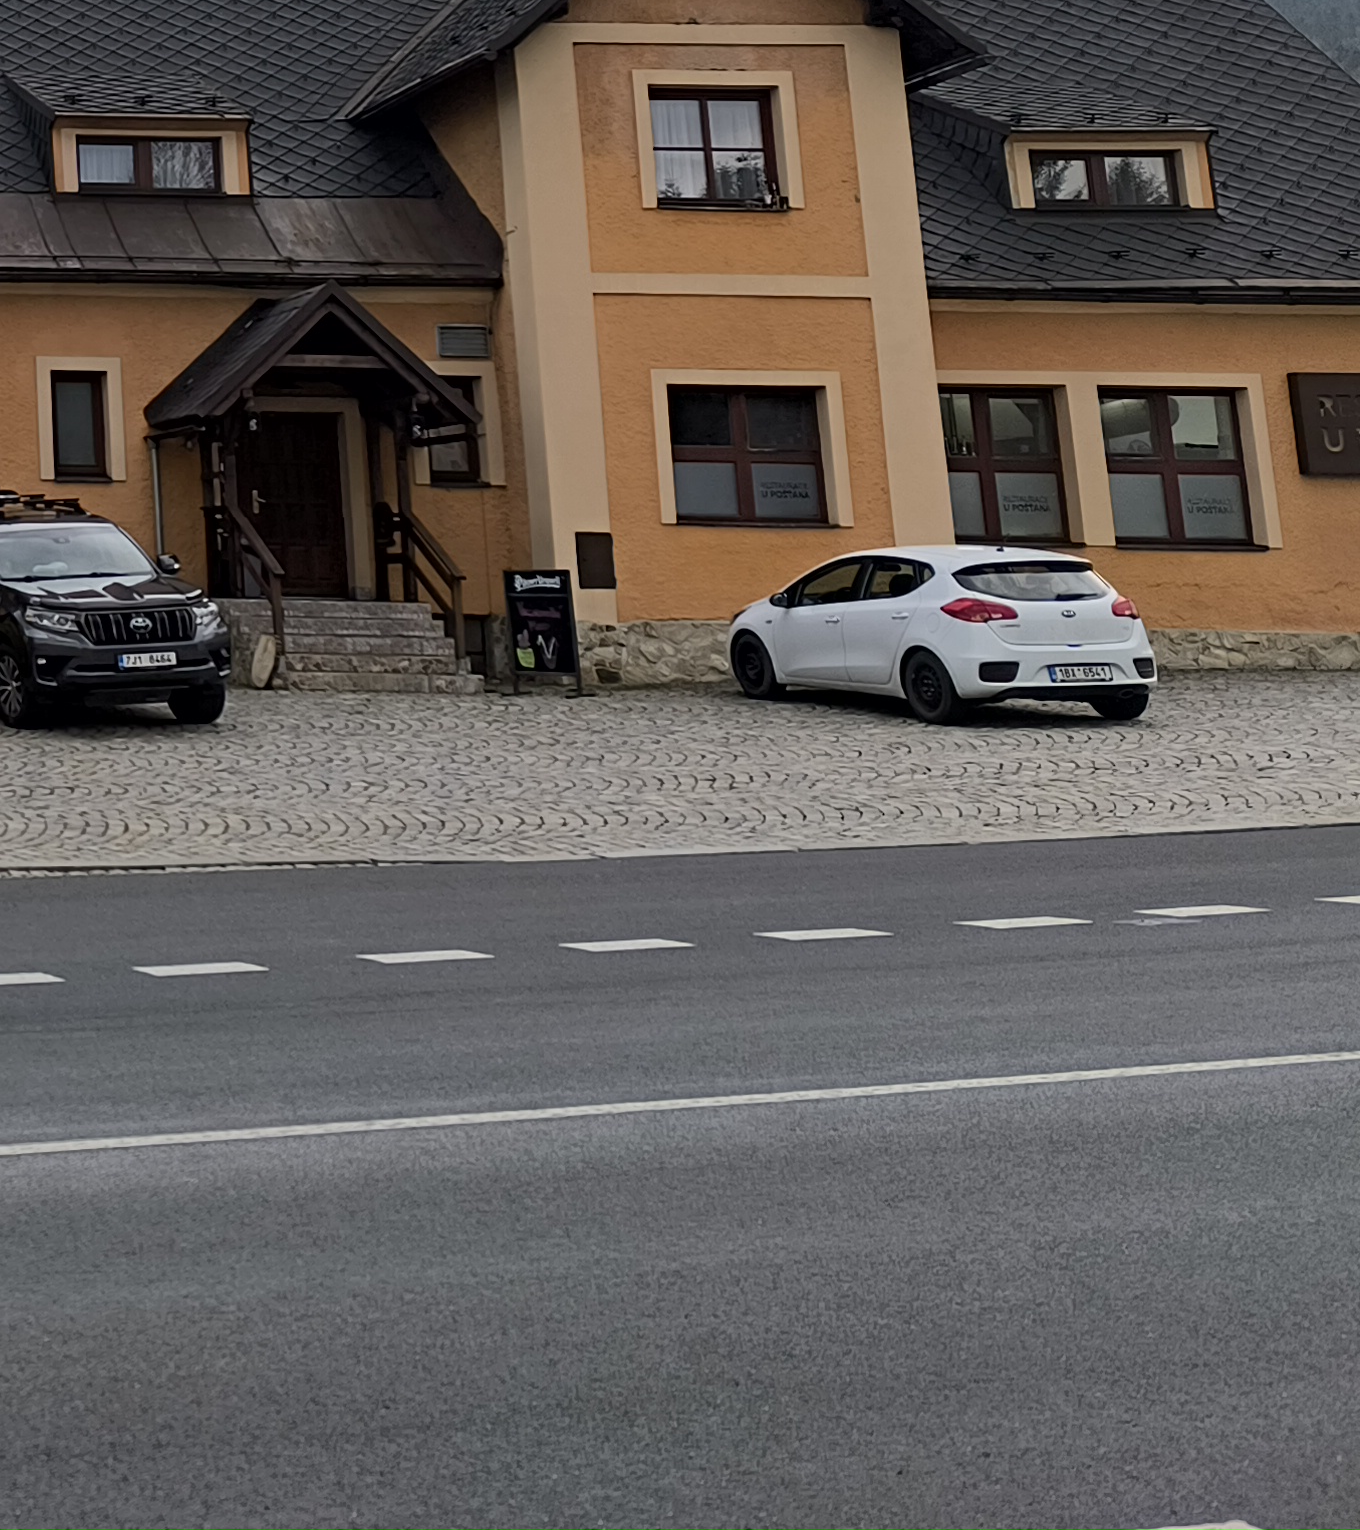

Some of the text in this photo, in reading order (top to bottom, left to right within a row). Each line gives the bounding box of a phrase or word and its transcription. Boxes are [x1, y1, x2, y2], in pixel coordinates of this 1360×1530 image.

[1321, 426, 1345, 452] U
[1059, 667, 1107, 678] 1BX 6541
